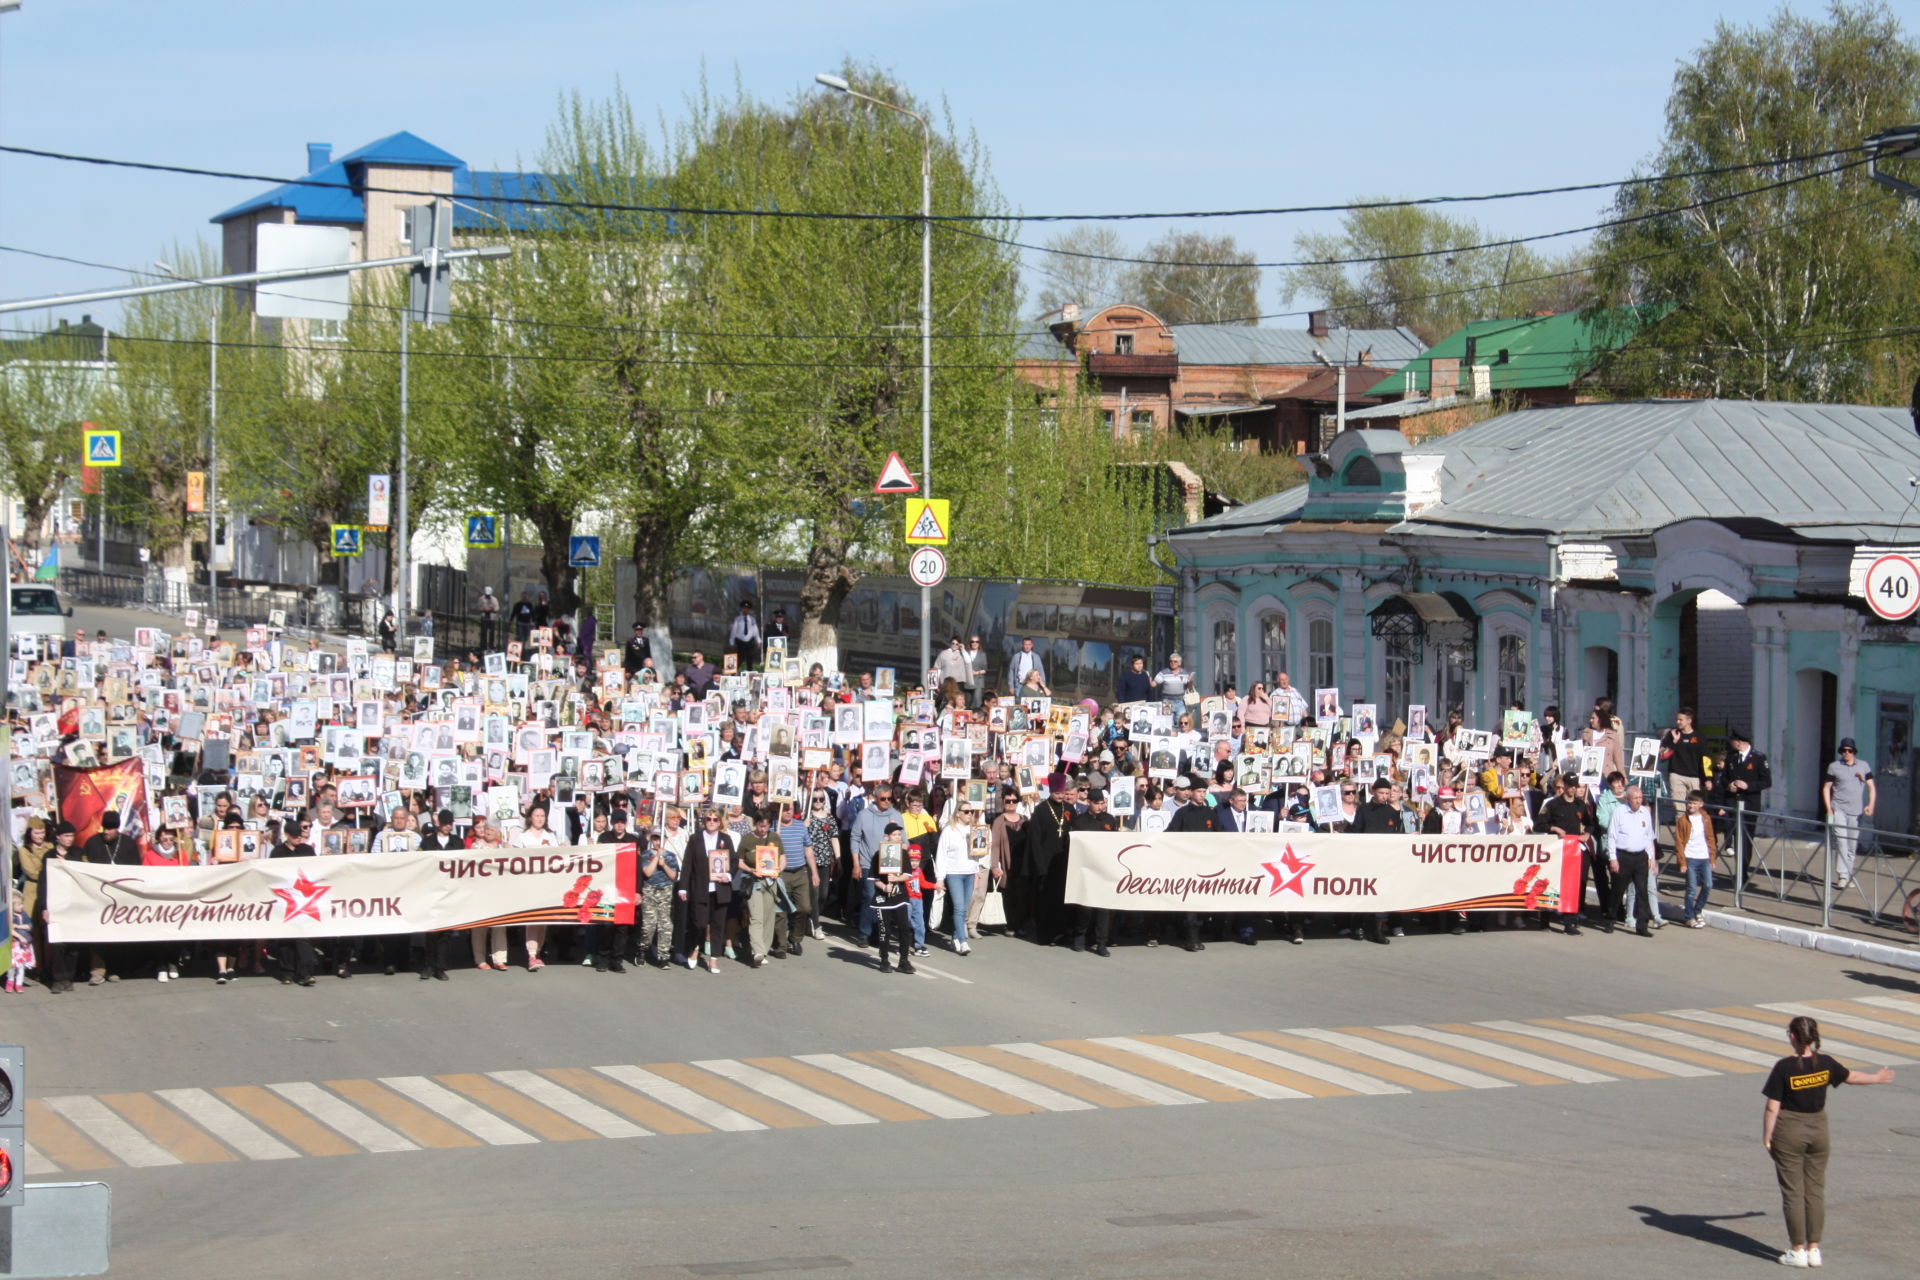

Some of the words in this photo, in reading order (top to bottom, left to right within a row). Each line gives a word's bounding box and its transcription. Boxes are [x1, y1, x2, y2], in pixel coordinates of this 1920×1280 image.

[920, 560, 937, 574] 20
[1880, 576, 1908, 598] 40
[1411, 843, 1551, 864] ЧИСТОПОЛЬ
[438, 854, 603, 879] ЧИСТОПОЛЬ
[1116, 844, 1265, 901] бессмертный
[1312, 876, 1378, 896] ПОЛК
[100, 878, 277, 929] бессмертный
[331, 896, 402, 919] ПОЛК
